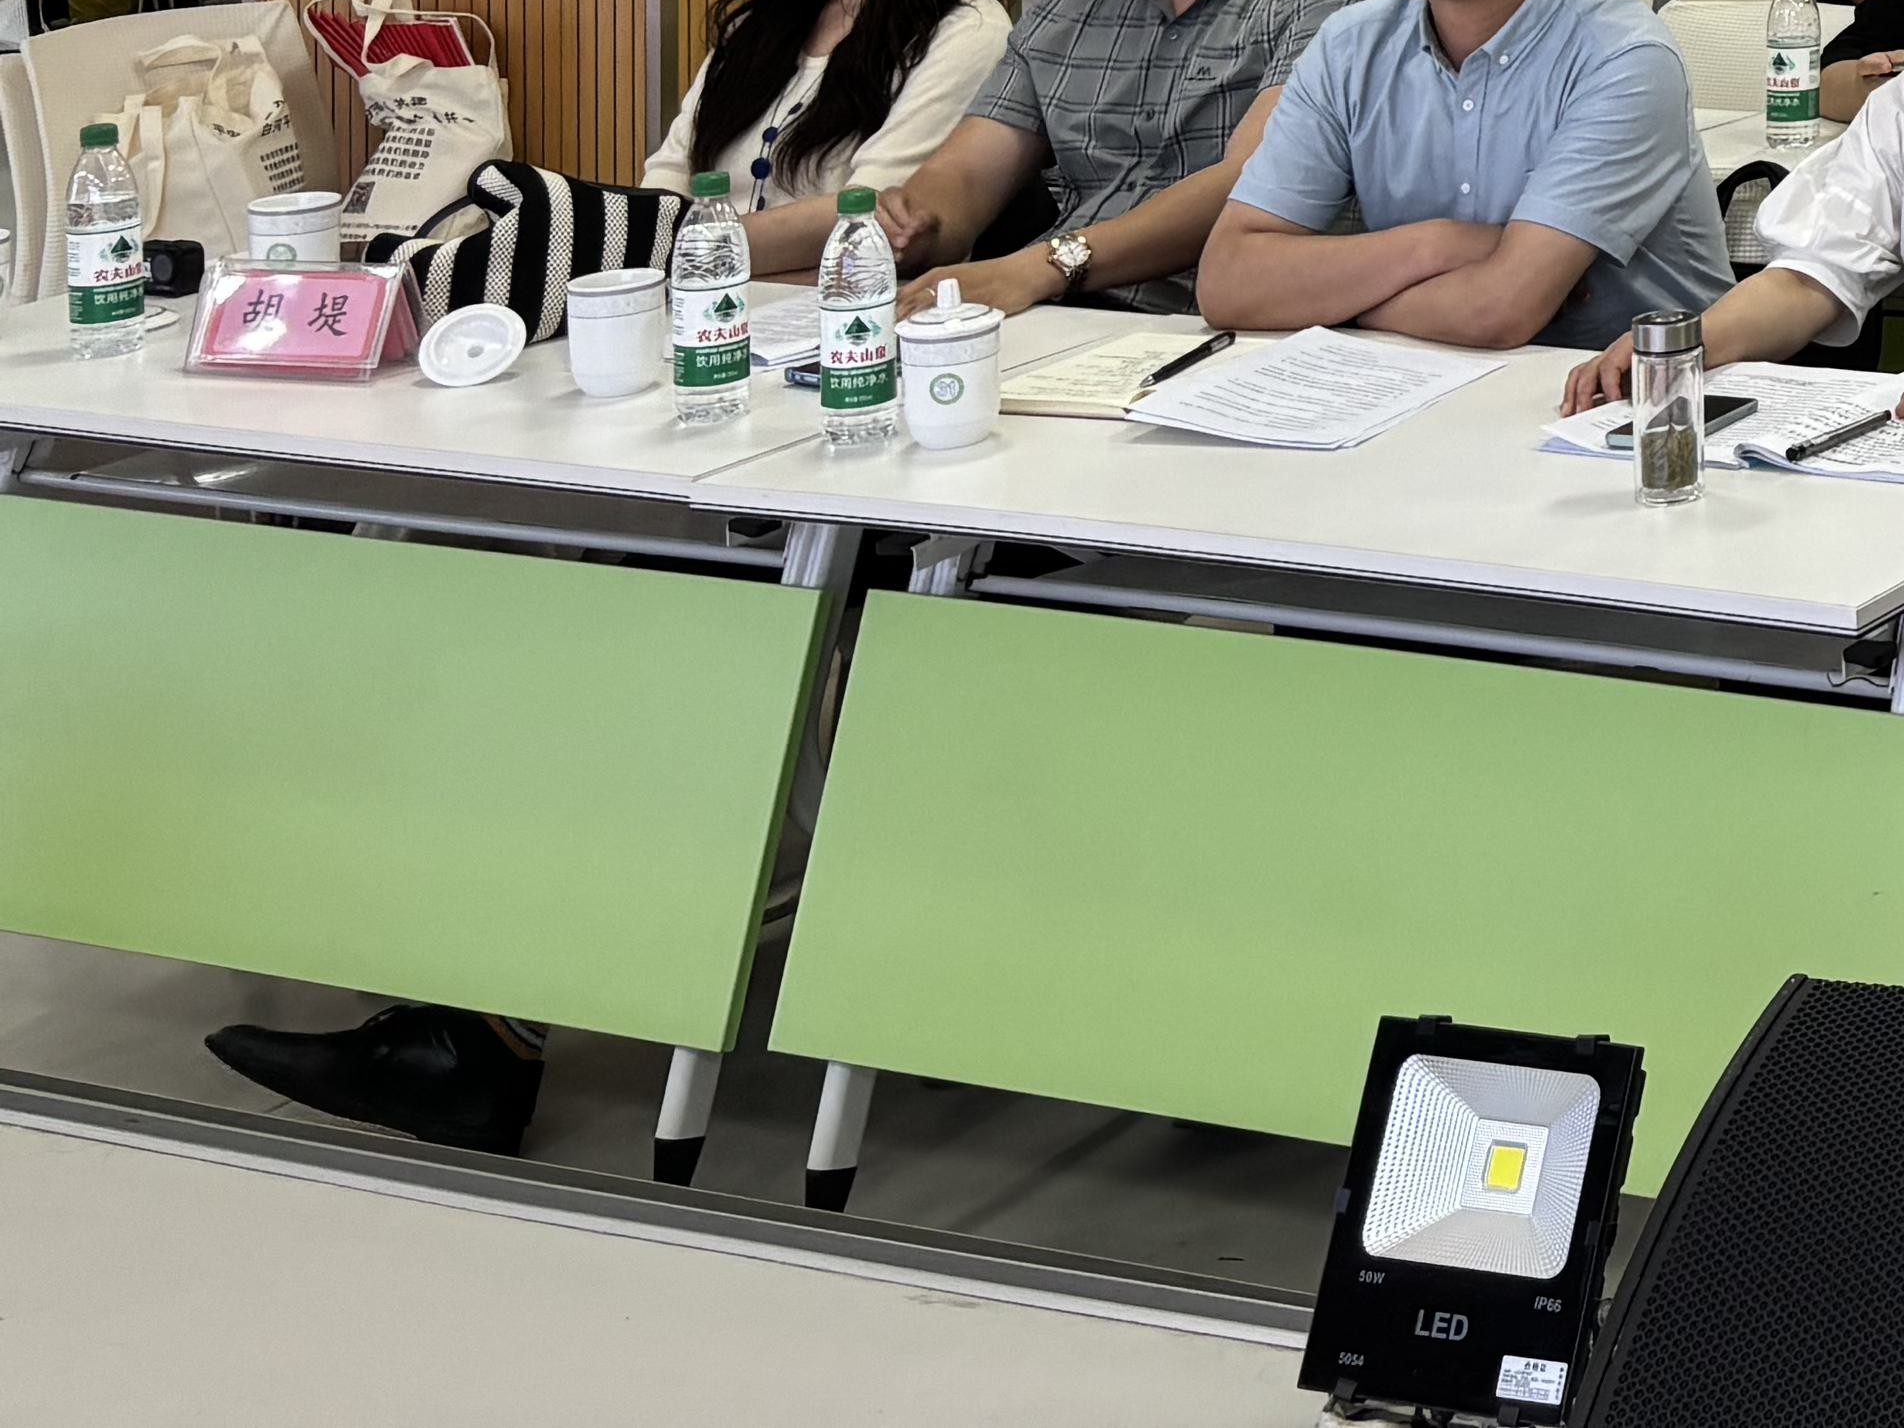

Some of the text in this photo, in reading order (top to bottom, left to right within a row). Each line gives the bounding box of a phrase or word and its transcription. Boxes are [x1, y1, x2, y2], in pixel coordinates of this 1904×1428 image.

[830, 344, 887, 365] 农夫山泉
[830, 372, 888, 390] 饮用纯净水
[1358, 1270, 1386, 1285] 50W
[1533, 1295, 1563, 1313] IP66
[1414, 1308, 1469, 1342] LED
